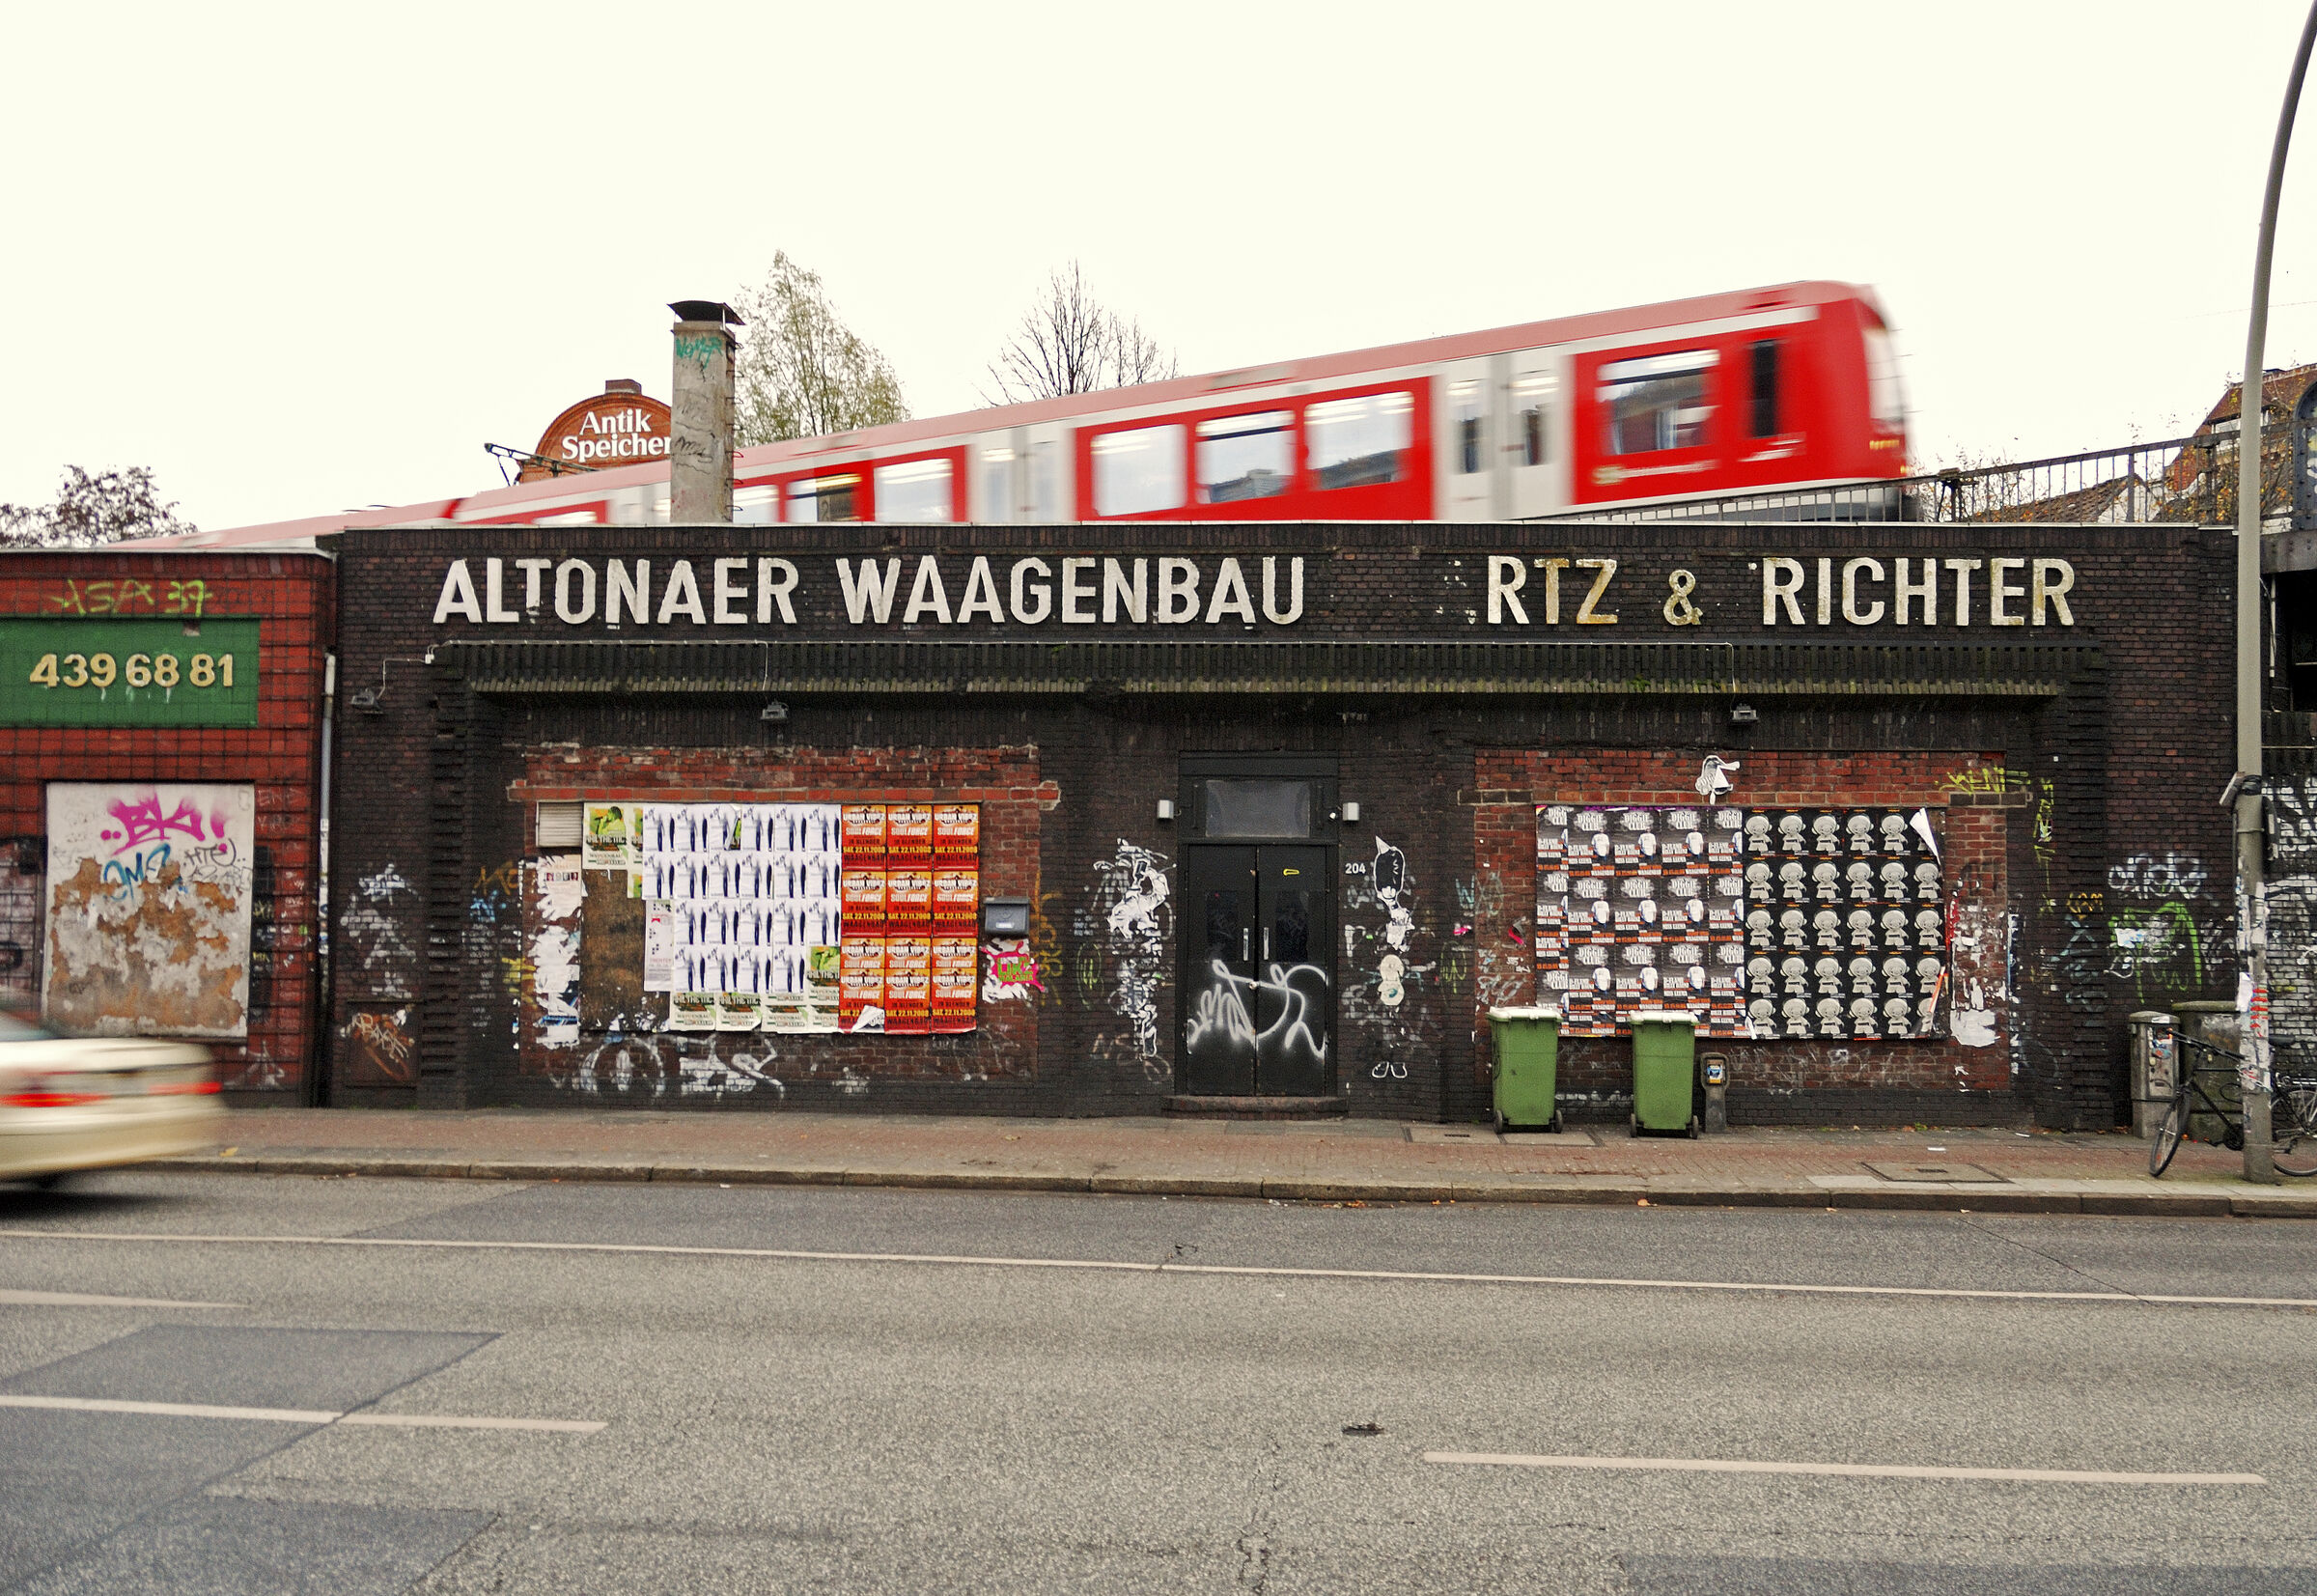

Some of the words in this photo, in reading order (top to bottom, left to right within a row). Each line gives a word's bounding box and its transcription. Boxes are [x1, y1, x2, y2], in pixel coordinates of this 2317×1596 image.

[579, 408, 652, 434] Antik
[433, 556, 798, 626] ALTONAER
[836, 555, 1303, 625] WAAGENBAU
[1488, 555, 1618, 625] RTZ
[1663, 570, 1703, 626] &
[1762, 557, 2075, 627] RICHTER
[29, 653, 117, 687] 439
[126, 654, 180, 687] 68
[189, 654, 233, 687] 81
[1344, 862, 1367, 875] 204
